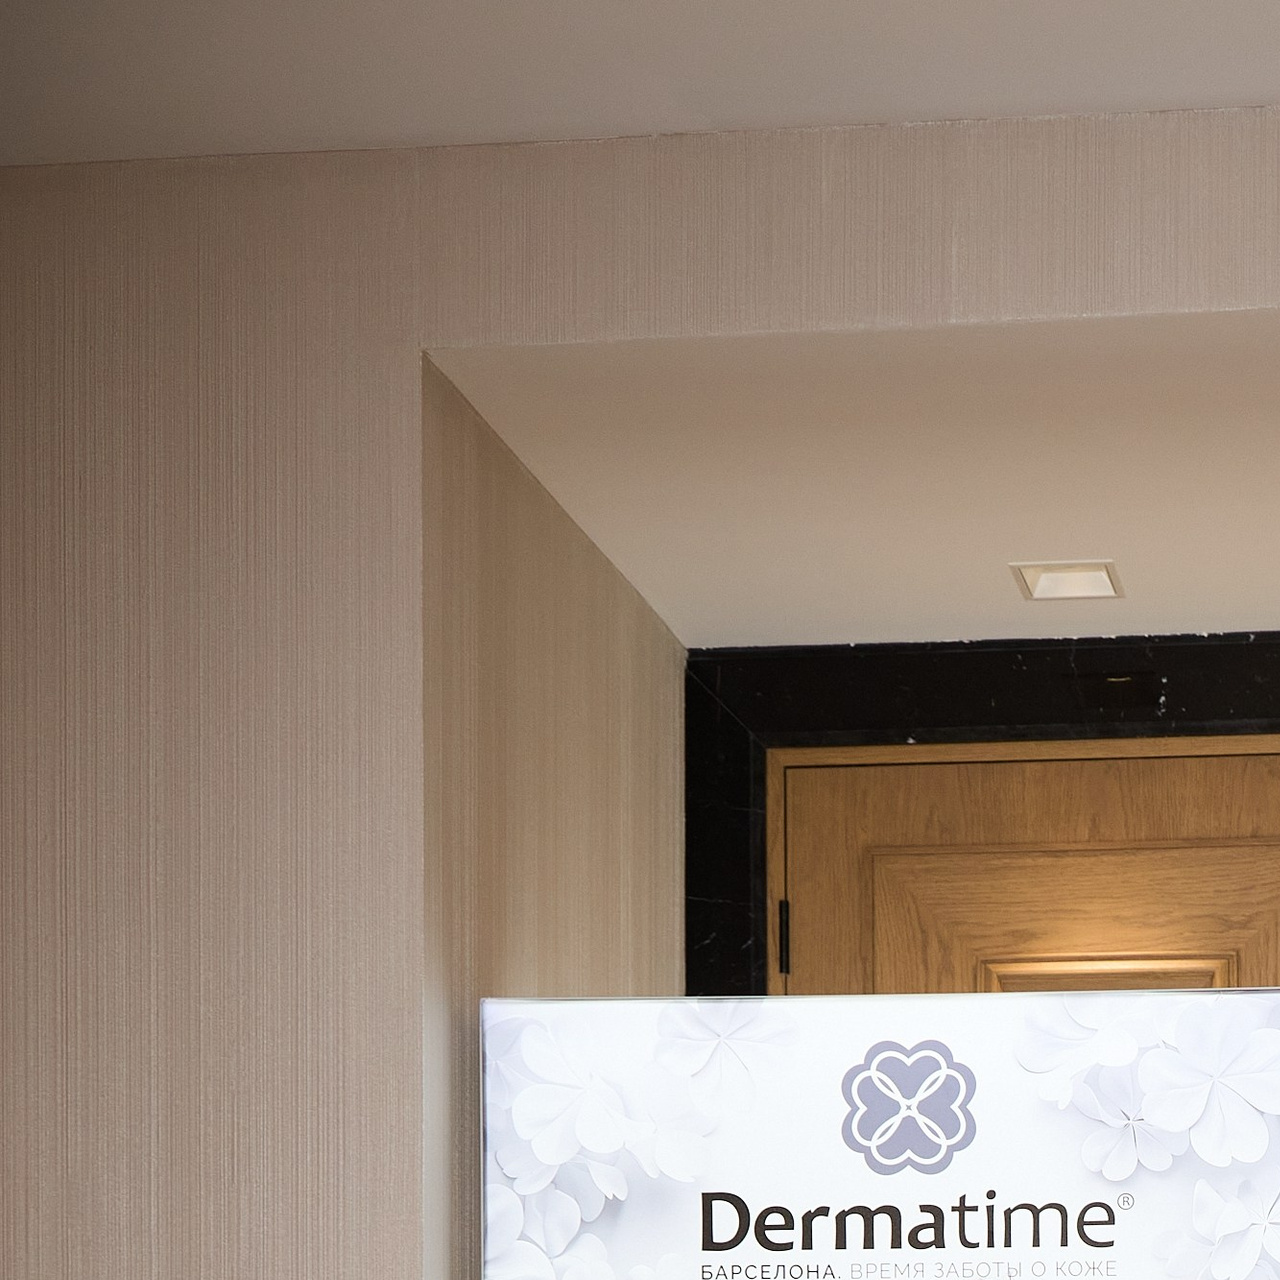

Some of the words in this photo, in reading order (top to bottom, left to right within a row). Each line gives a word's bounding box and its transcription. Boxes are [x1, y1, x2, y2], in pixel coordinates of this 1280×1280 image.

[700, 1262, 842, 1280] БАРСЕЛОНА.
[850, 1262, 926, 1280] ВРЕМЯ
[933, 1260, 1026, 1279] ЗАБОТЫ
[1031, 1260, 1046, 1278] О
[1054, 1259, 1118, 1278] КОЖЕ
